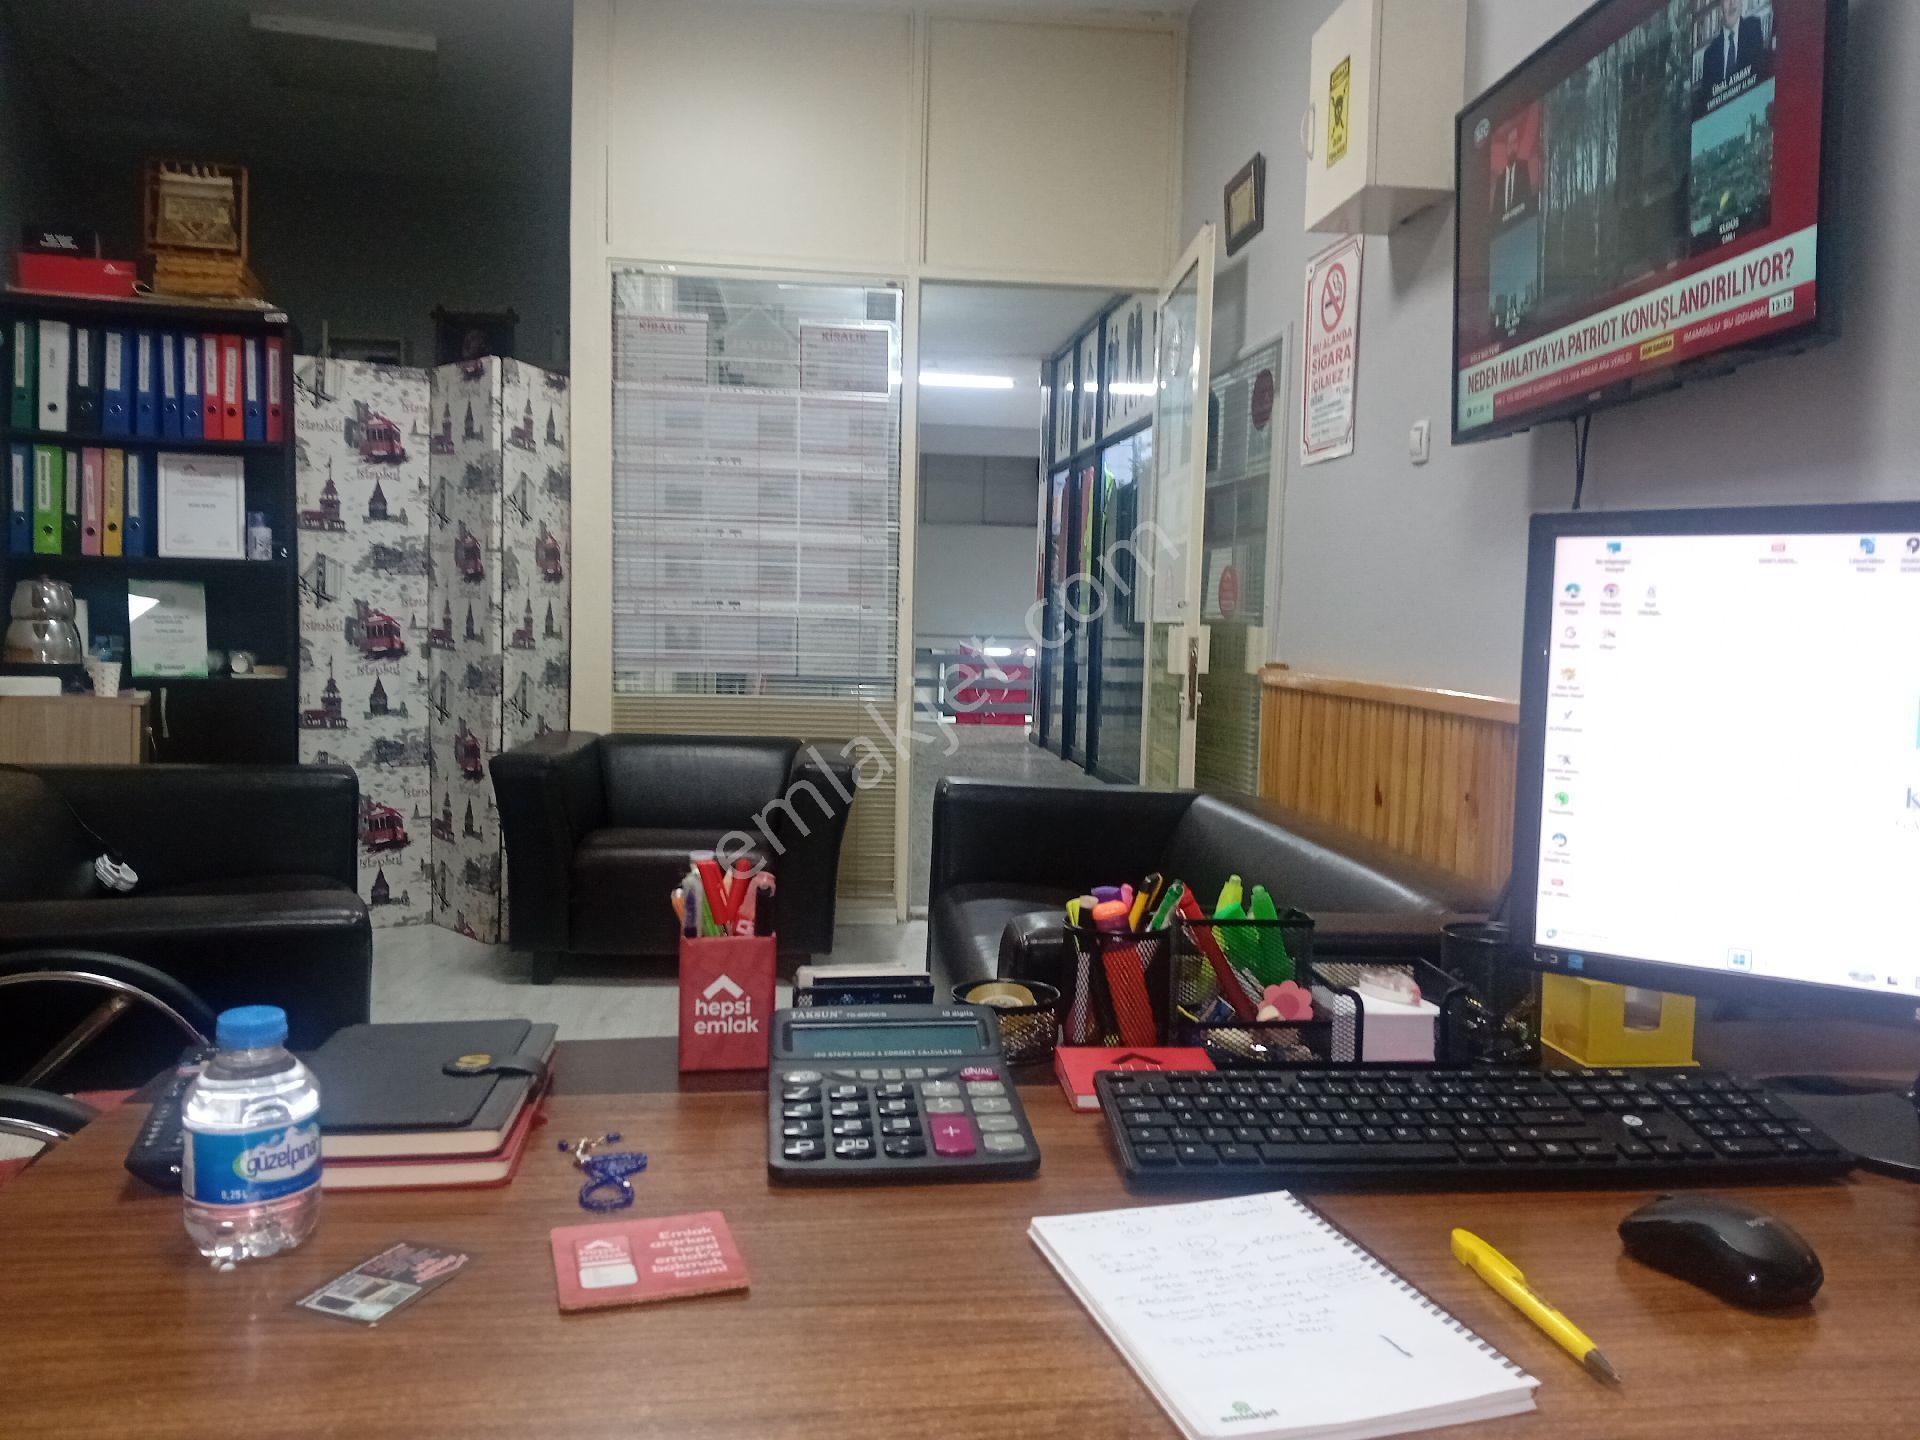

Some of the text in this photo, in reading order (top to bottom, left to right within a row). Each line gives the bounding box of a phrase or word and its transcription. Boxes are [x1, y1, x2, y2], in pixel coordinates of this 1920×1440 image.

[1467, 366, 1498, 396] NEDEN
[1500, 340, 1566, 383] MALATYA'YA
[1567, 316, 1618, 357] PATRIOT
[1621, 247, 1795, 339] KONUŞLANDIRILIYOR?
[694, 995, 752, 1018] hepsi
[693, 1015, 759, 1036] emlak
